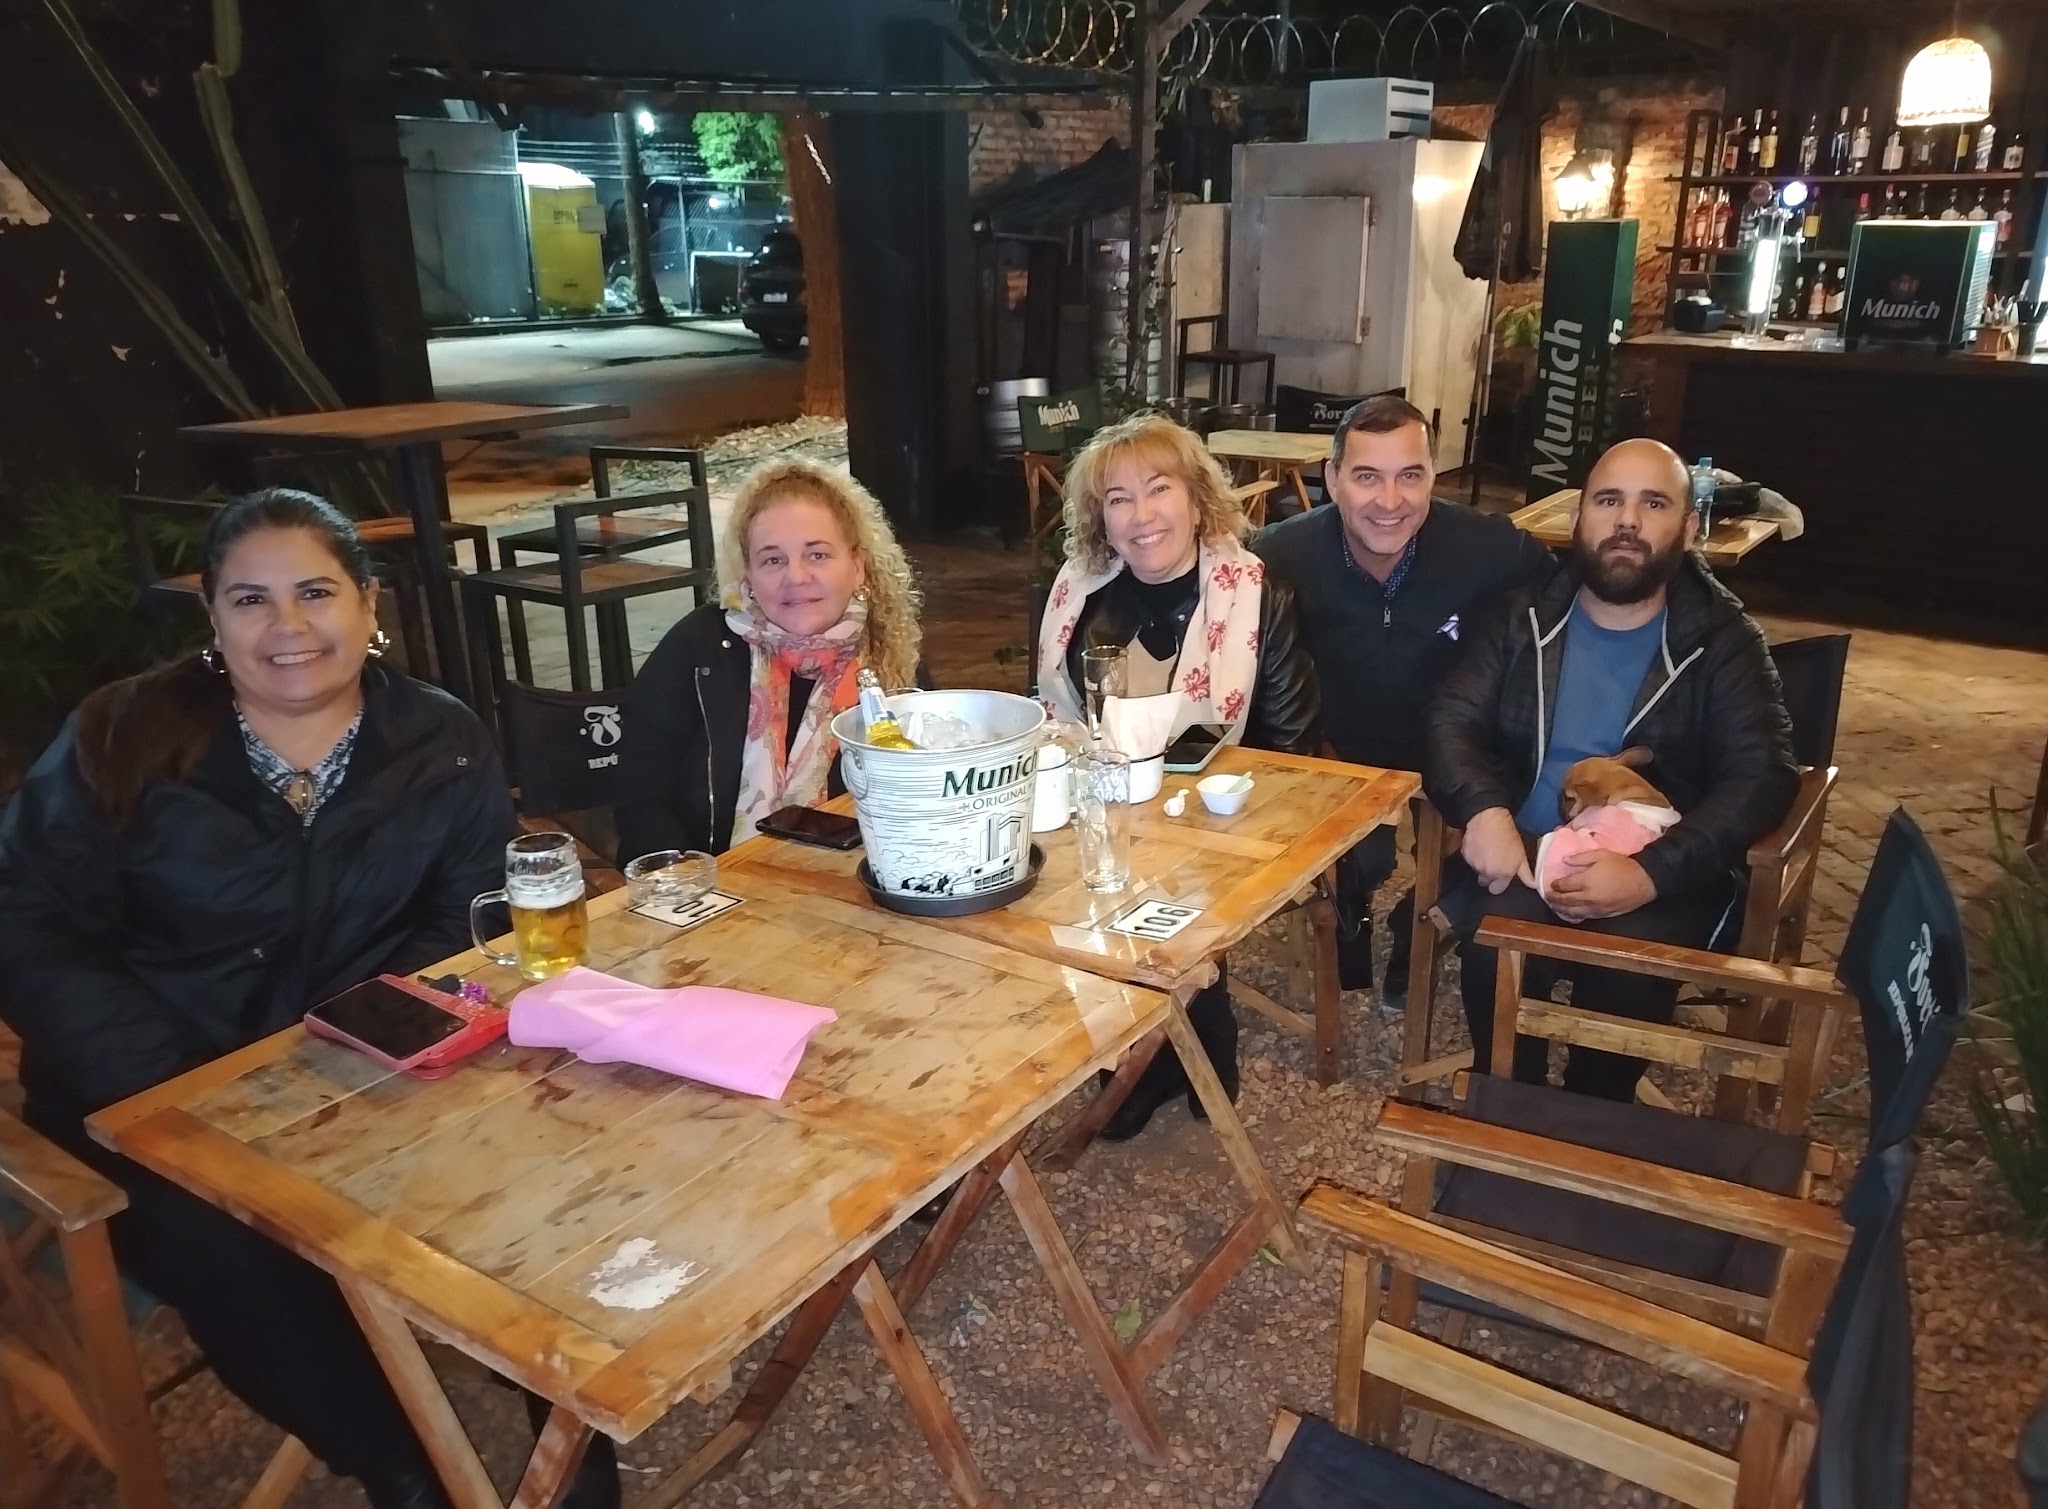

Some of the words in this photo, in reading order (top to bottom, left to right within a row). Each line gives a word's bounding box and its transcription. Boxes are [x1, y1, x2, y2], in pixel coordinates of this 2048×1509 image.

[1860, 298, 1941, 320] Munich
[1531, 319, 1583, 485] Munich
[1577, 365, 1600, 443] BEER
[942, 746, 1038, 798] Munich
[672, 900, 718, 918] 10
